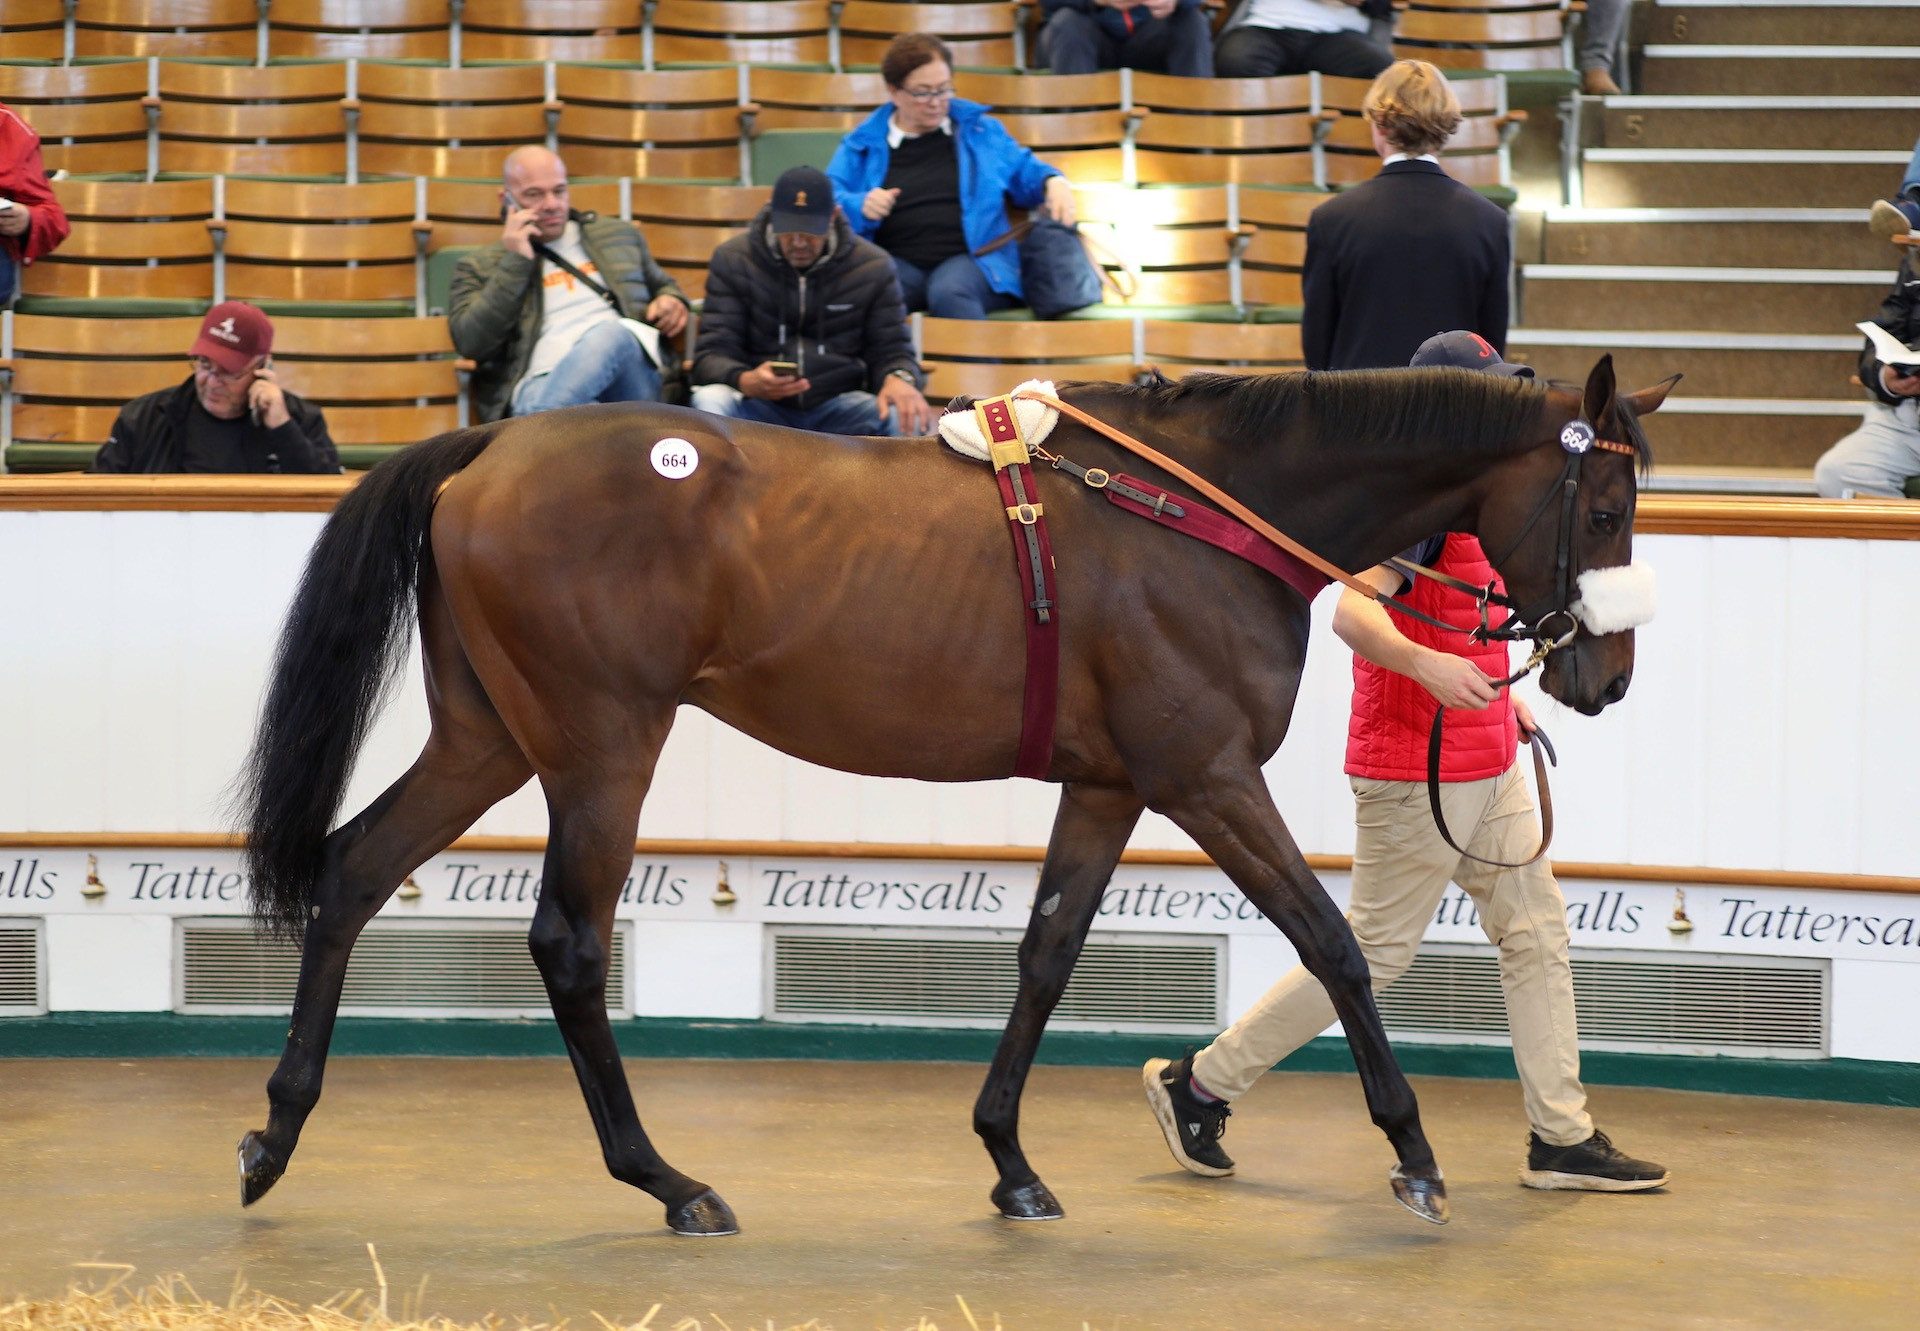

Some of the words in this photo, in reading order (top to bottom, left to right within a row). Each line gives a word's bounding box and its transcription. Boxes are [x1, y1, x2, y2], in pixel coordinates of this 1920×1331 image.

[1561, 427, 1590, 453] 664
[662, 453, 687, 468] 664
[762, 869, 1007, 913] Tattersalls
[1720, 898, 1920, 947] Tattersa
